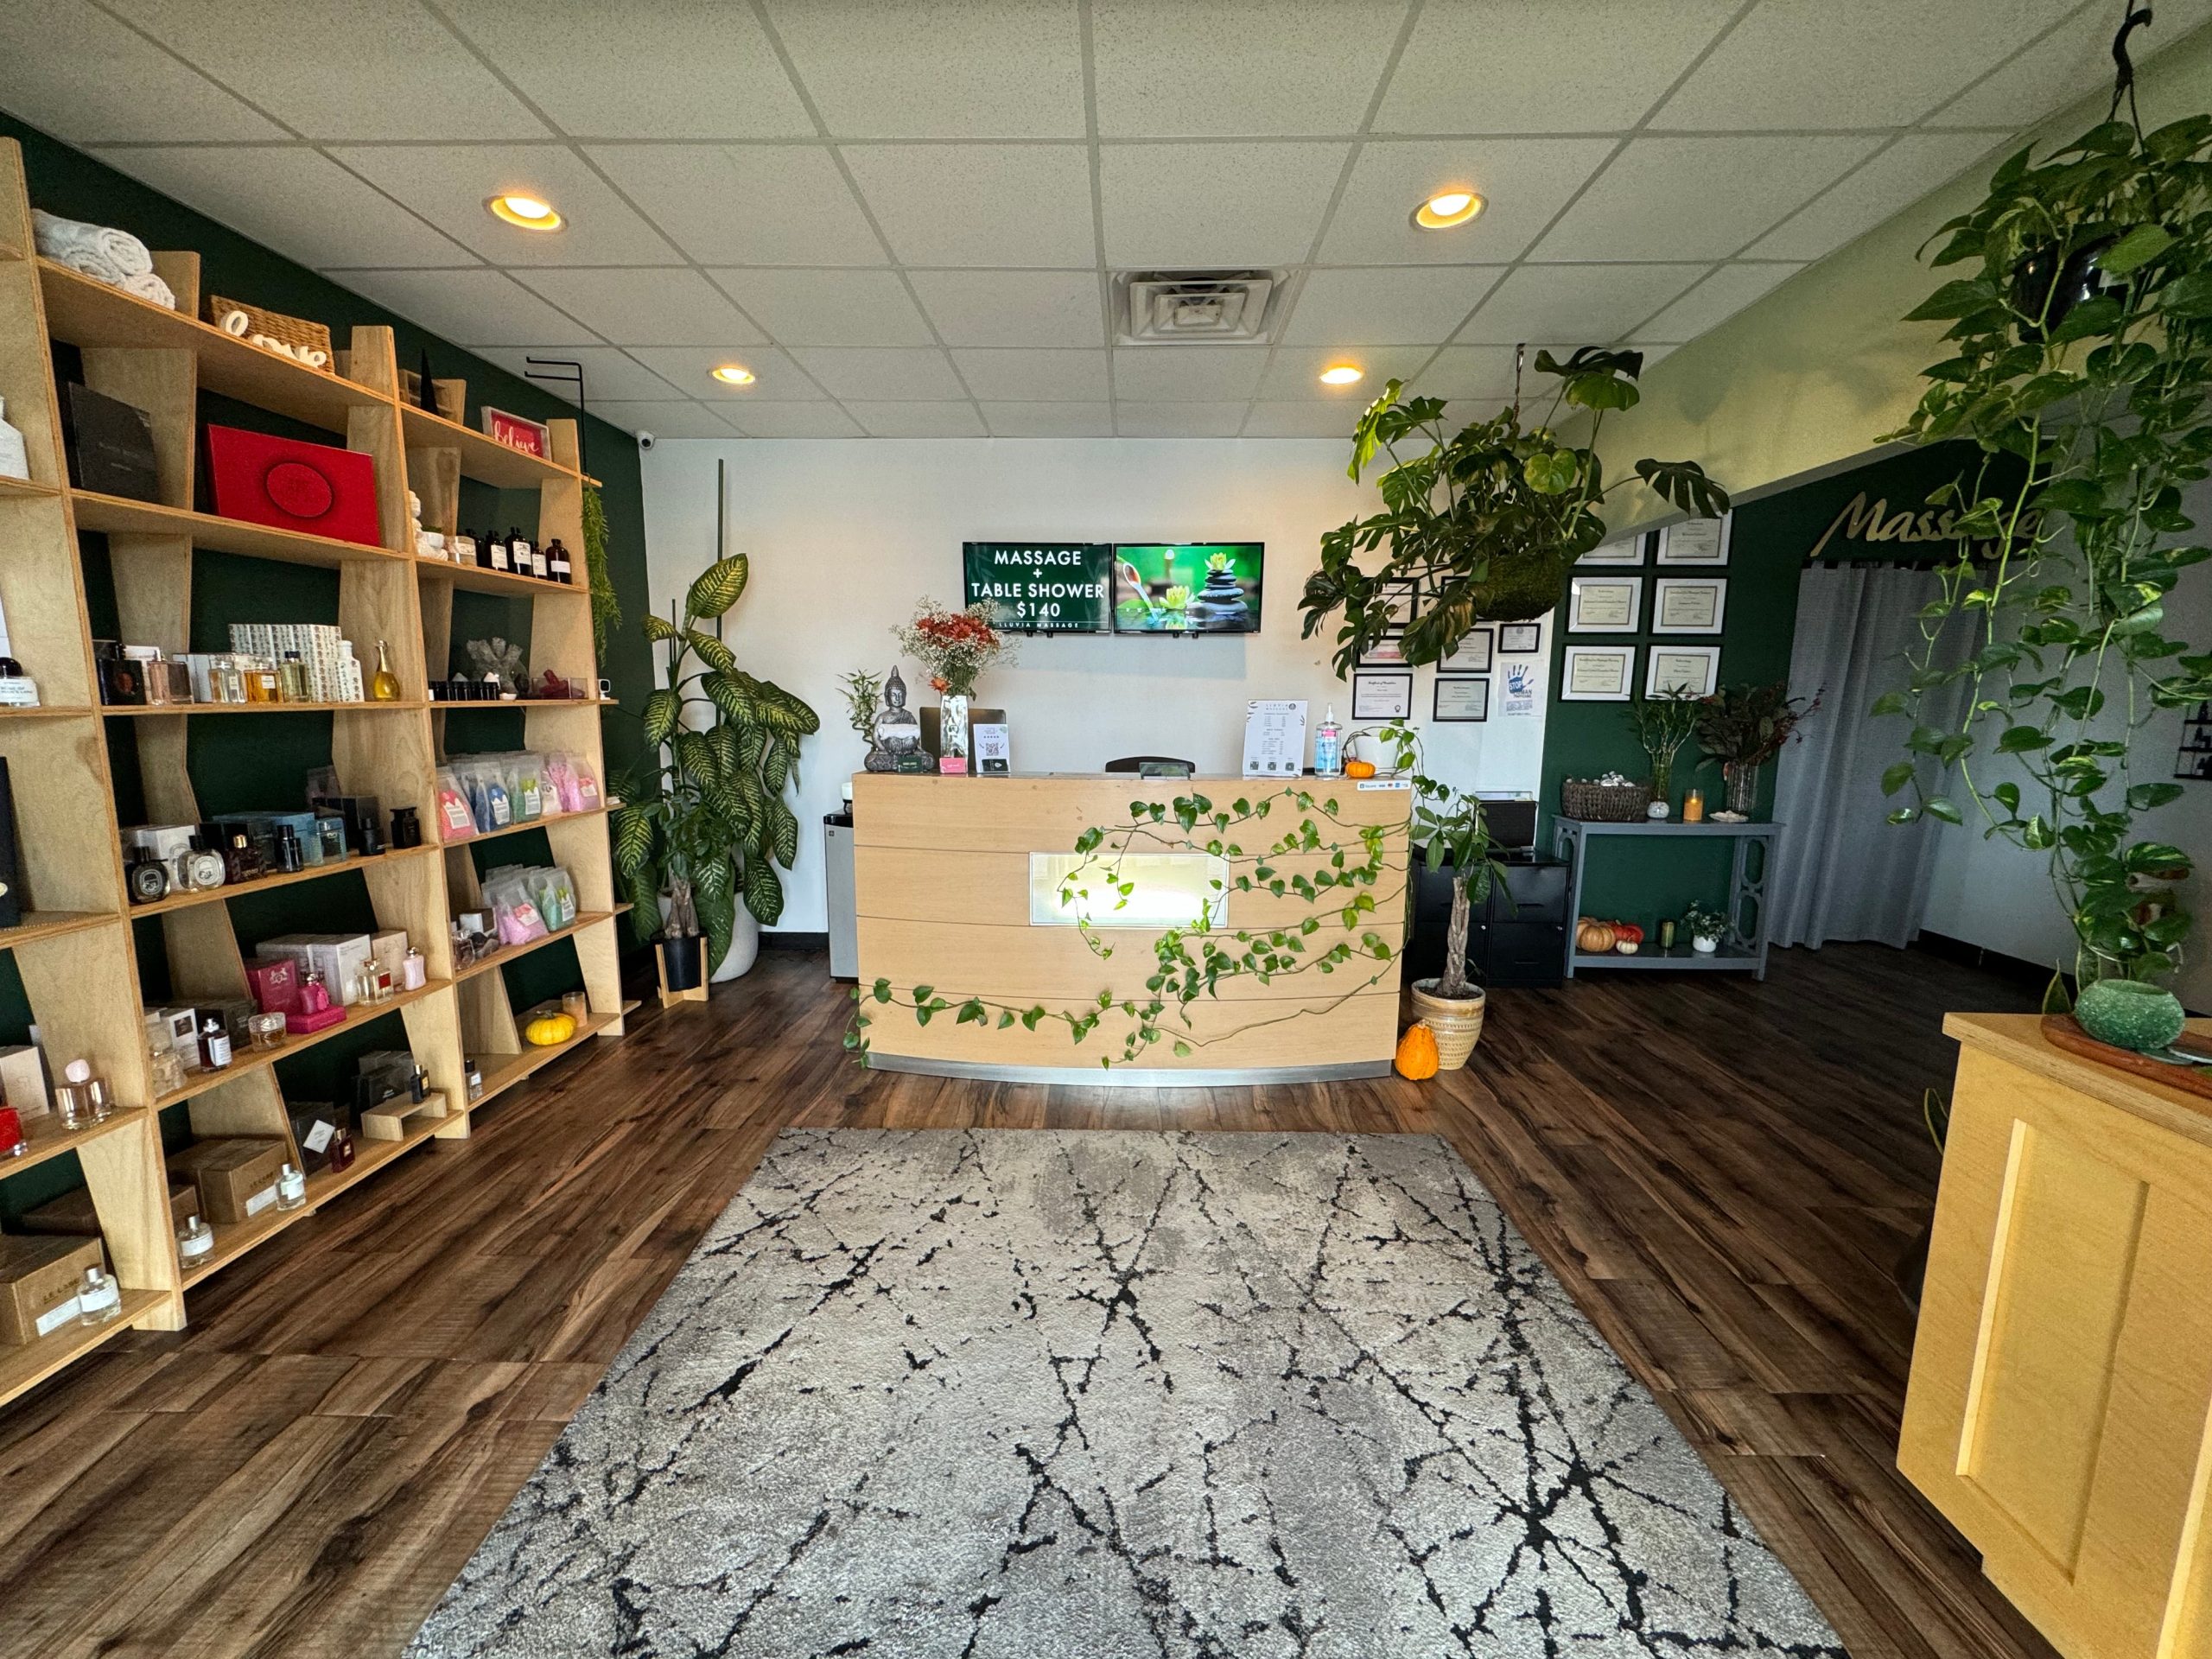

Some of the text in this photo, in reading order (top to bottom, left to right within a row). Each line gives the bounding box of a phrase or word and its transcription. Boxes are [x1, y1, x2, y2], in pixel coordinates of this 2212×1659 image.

[1809, 491, 2042, 560] Massge
[994, 550, 1082, 566] MASSAGE
[1033, 568, 1043, 578] +
[970, 582, 1104, 598] TABLE SHOWER
[1016, 601, 1061, 618] $140
[1509, 680, 1522, 690] STOP
